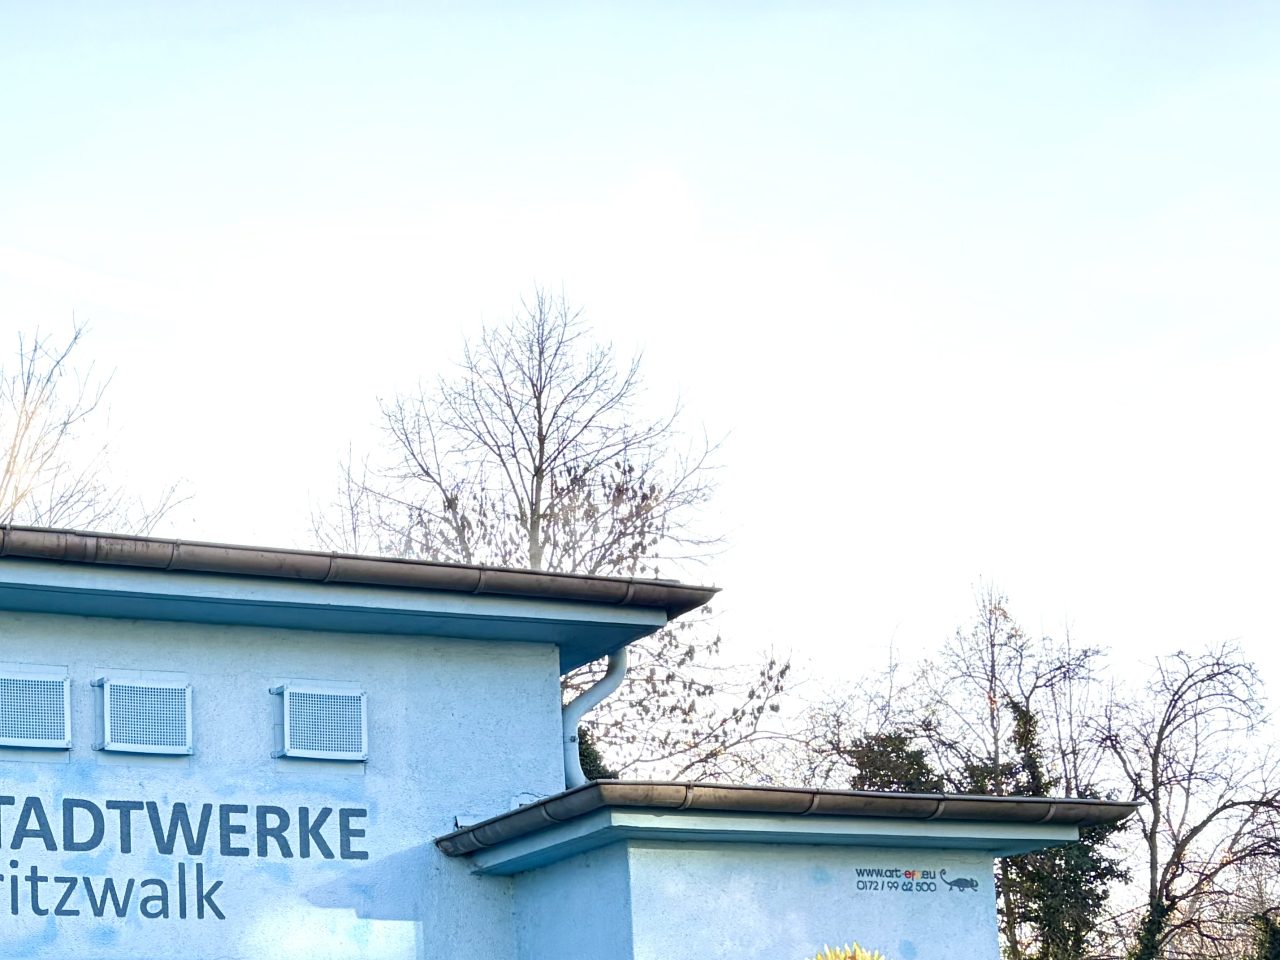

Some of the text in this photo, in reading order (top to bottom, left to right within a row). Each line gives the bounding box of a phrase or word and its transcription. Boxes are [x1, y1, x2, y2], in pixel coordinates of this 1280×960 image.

[856, 880, 879, 891] 0172
[887, 881, 899, 891] 99
[901, 881, 913, 892] 62
[915, 881, 937, 892] 500
